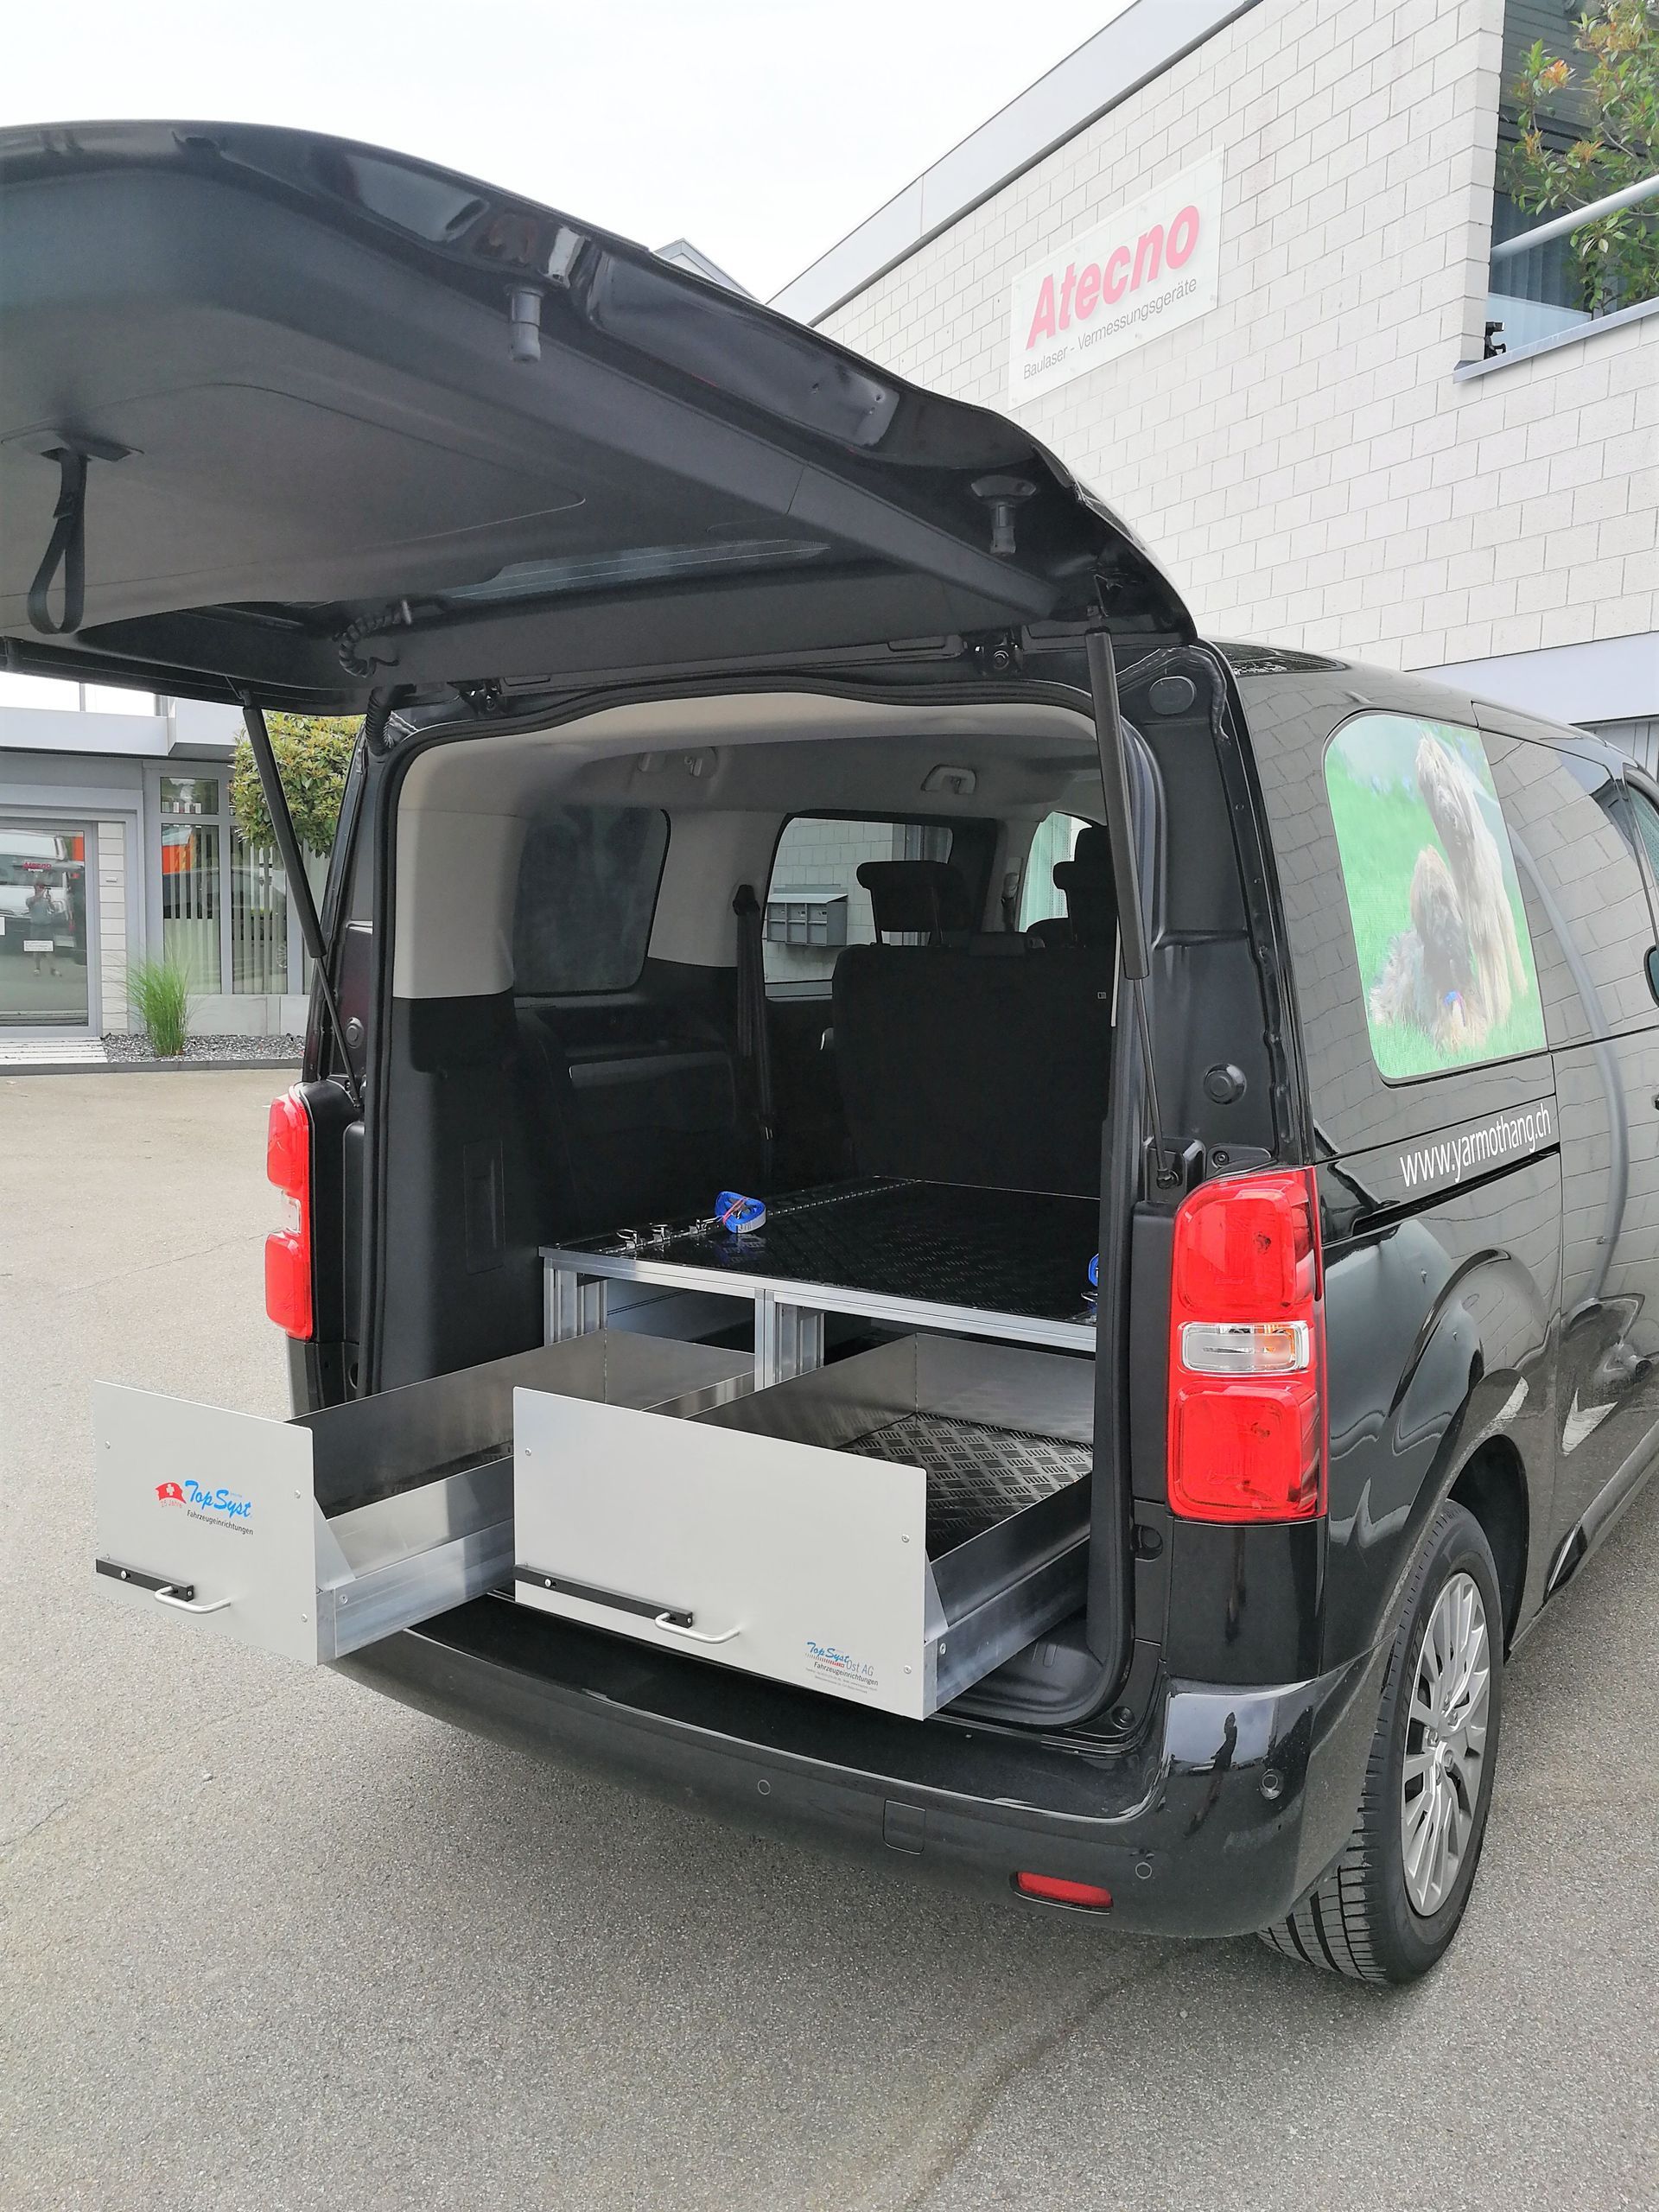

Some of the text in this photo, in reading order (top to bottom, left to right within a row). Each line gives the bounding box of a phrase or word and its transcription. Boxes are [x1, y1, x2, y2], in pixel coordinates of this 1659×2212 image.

[1026, 205, 1200, 351] Atecno
[1024, 345, 1068, 379] Baulaser
[1077, 277, 1197, 350] Vermessungsgeräte
[1400, 1103, 1552, 1187] www.yarmothang.ch
[187, 1510, 254, 1535] Fahrzeugeinrichtungen
[814, 1661, 879, 1686] Fahrzeugeinrichtungen
[847, 1659, 860, 1673] Ost
[861, 1663, 874, 1677] AG
